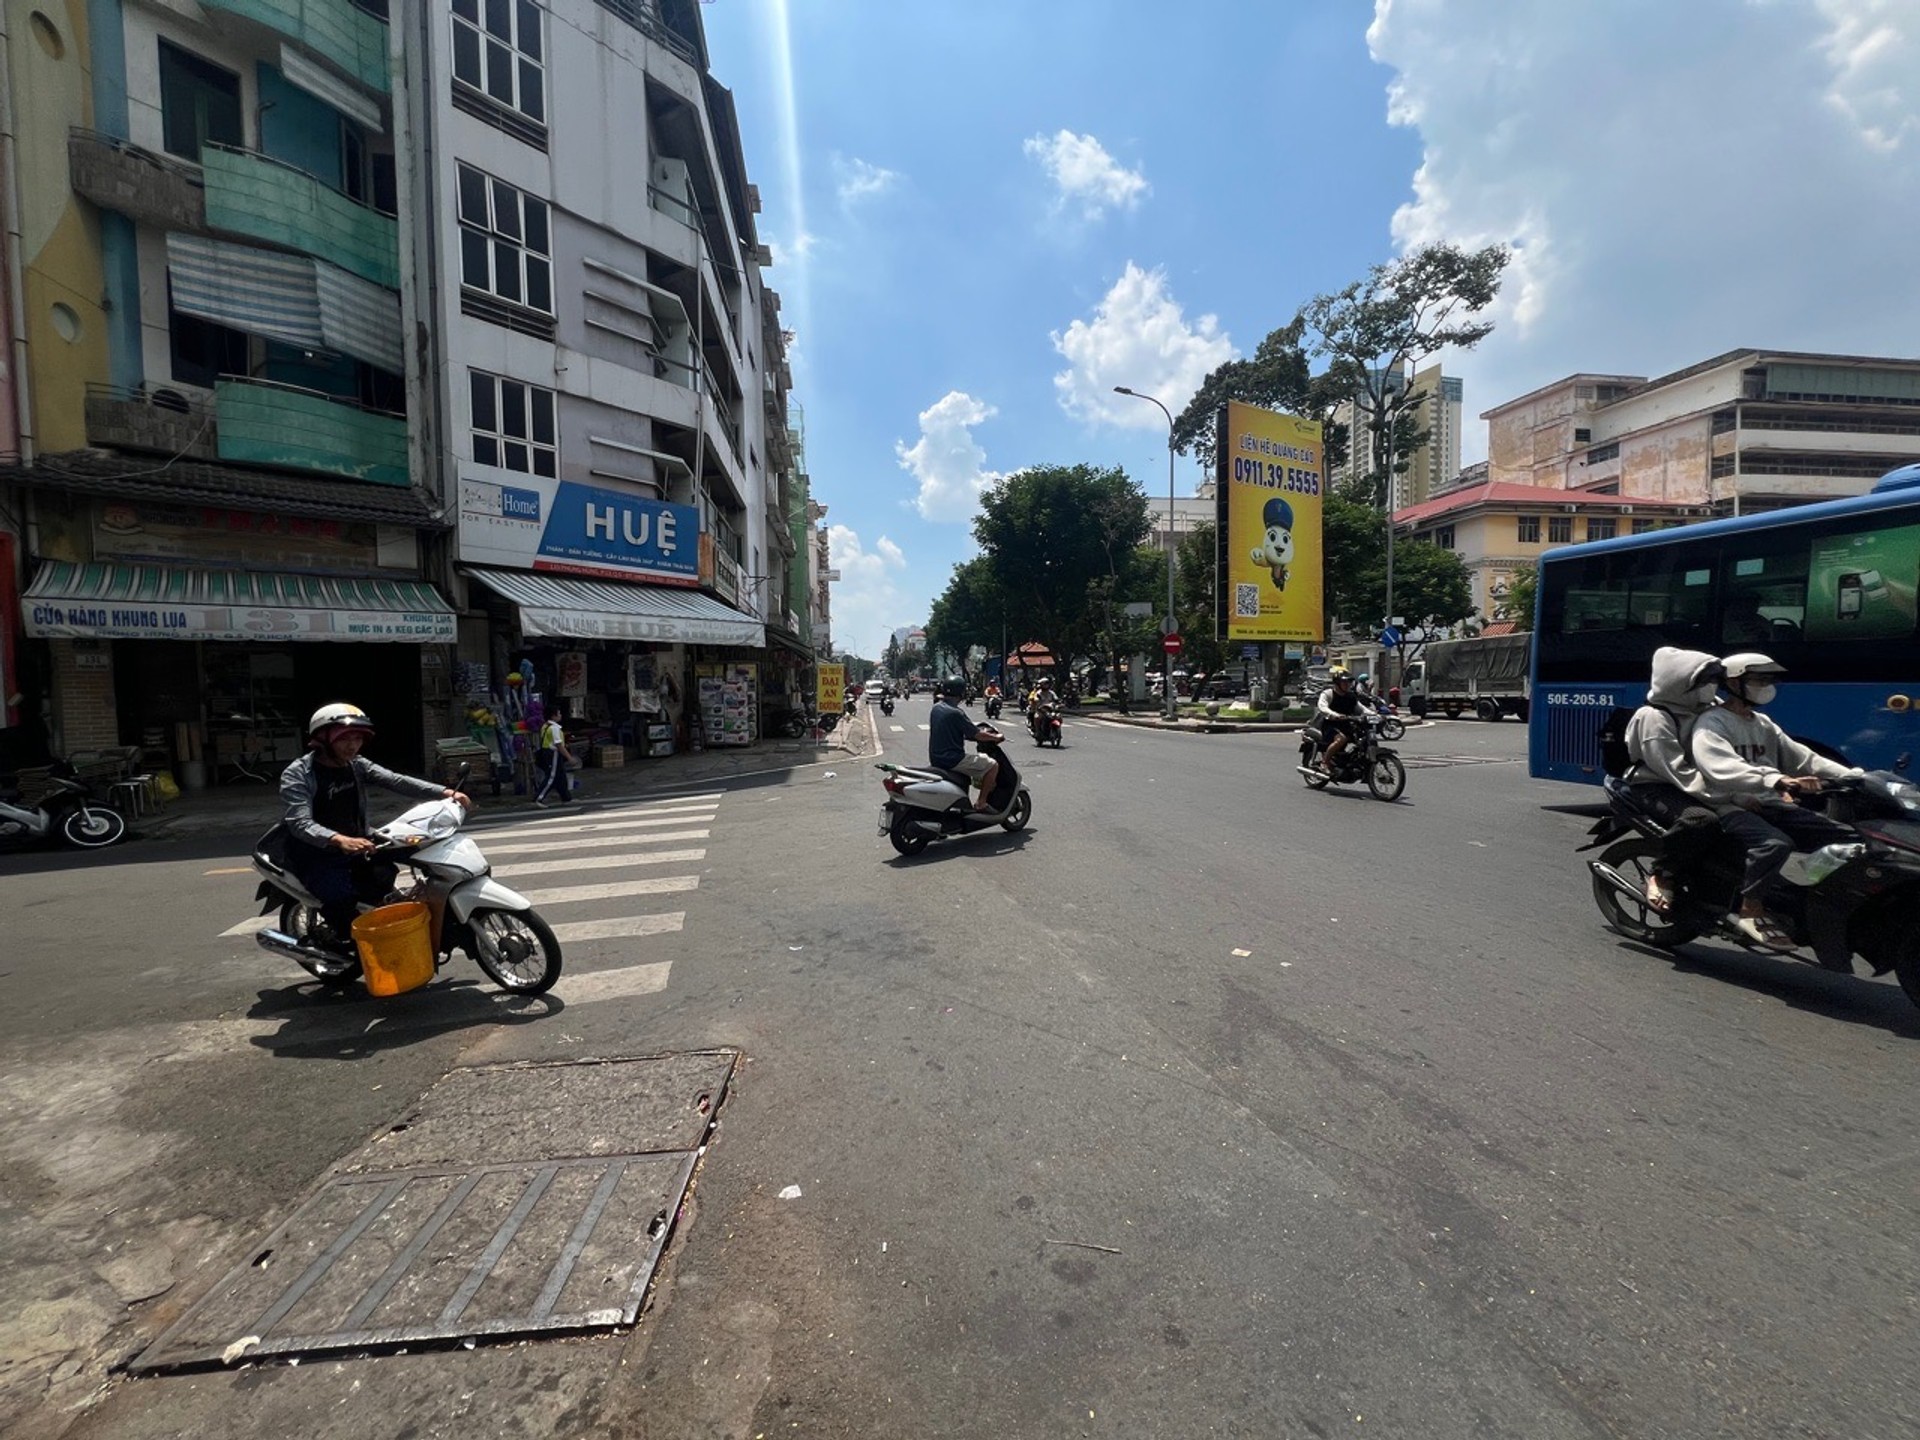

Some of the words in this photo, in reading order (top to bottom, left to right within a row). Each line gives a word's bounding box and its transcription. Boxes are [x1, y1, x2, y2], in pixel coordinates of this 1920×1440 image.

[1240, 433, 1258, 450] LIÊN
[1272, 442, 1297, 459] QUẢNG
[1234, 457, 1319, 496] 0911.39.5555
[503, 494, 537, 515] Home
[488, 518, 515, 527] EASY
[520, 523, 541, 531] LIFE
[586, 502, 677, 557] HUỆ
[33, 602, 64, 625] CỬA
[68, 606, 107, 627] HÀNG
[112, 609, 158, 628] KHUNG
[189, 607, 346, 635] 131
[402, 614, 434, 623] KHUNG
[372, 625, 383, 633] IN
[386, 626, 393, 634] &
[822, 677, 839, 687] ĐẠI
[823, 689, 836, 698] AN
[1547, 693, 1615, 706] 50E-205.81
